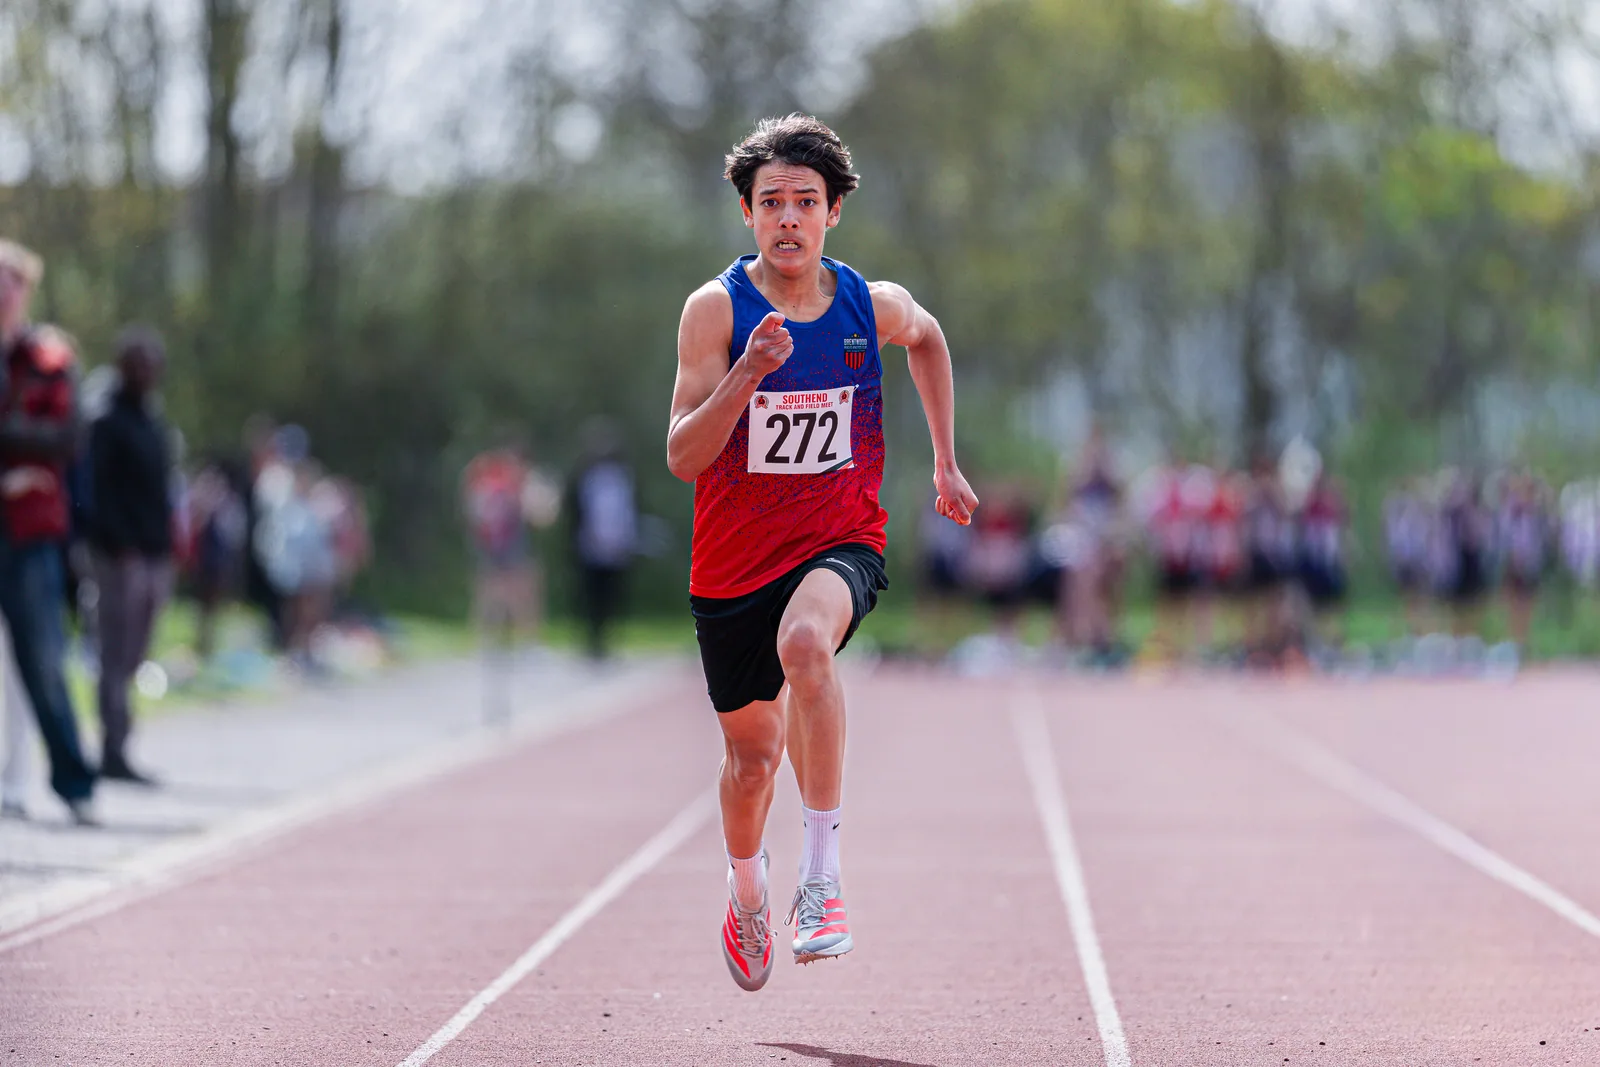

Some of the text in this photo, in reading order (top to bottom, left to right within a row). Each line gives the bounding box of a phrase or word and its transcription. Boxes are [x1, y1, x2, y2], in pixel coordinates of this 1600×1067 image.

[843, 338, 868, 346] BRENTWOOD
[782, 393, 828, 404] SOUTHEND
[765, 411, 838, 463] 272
